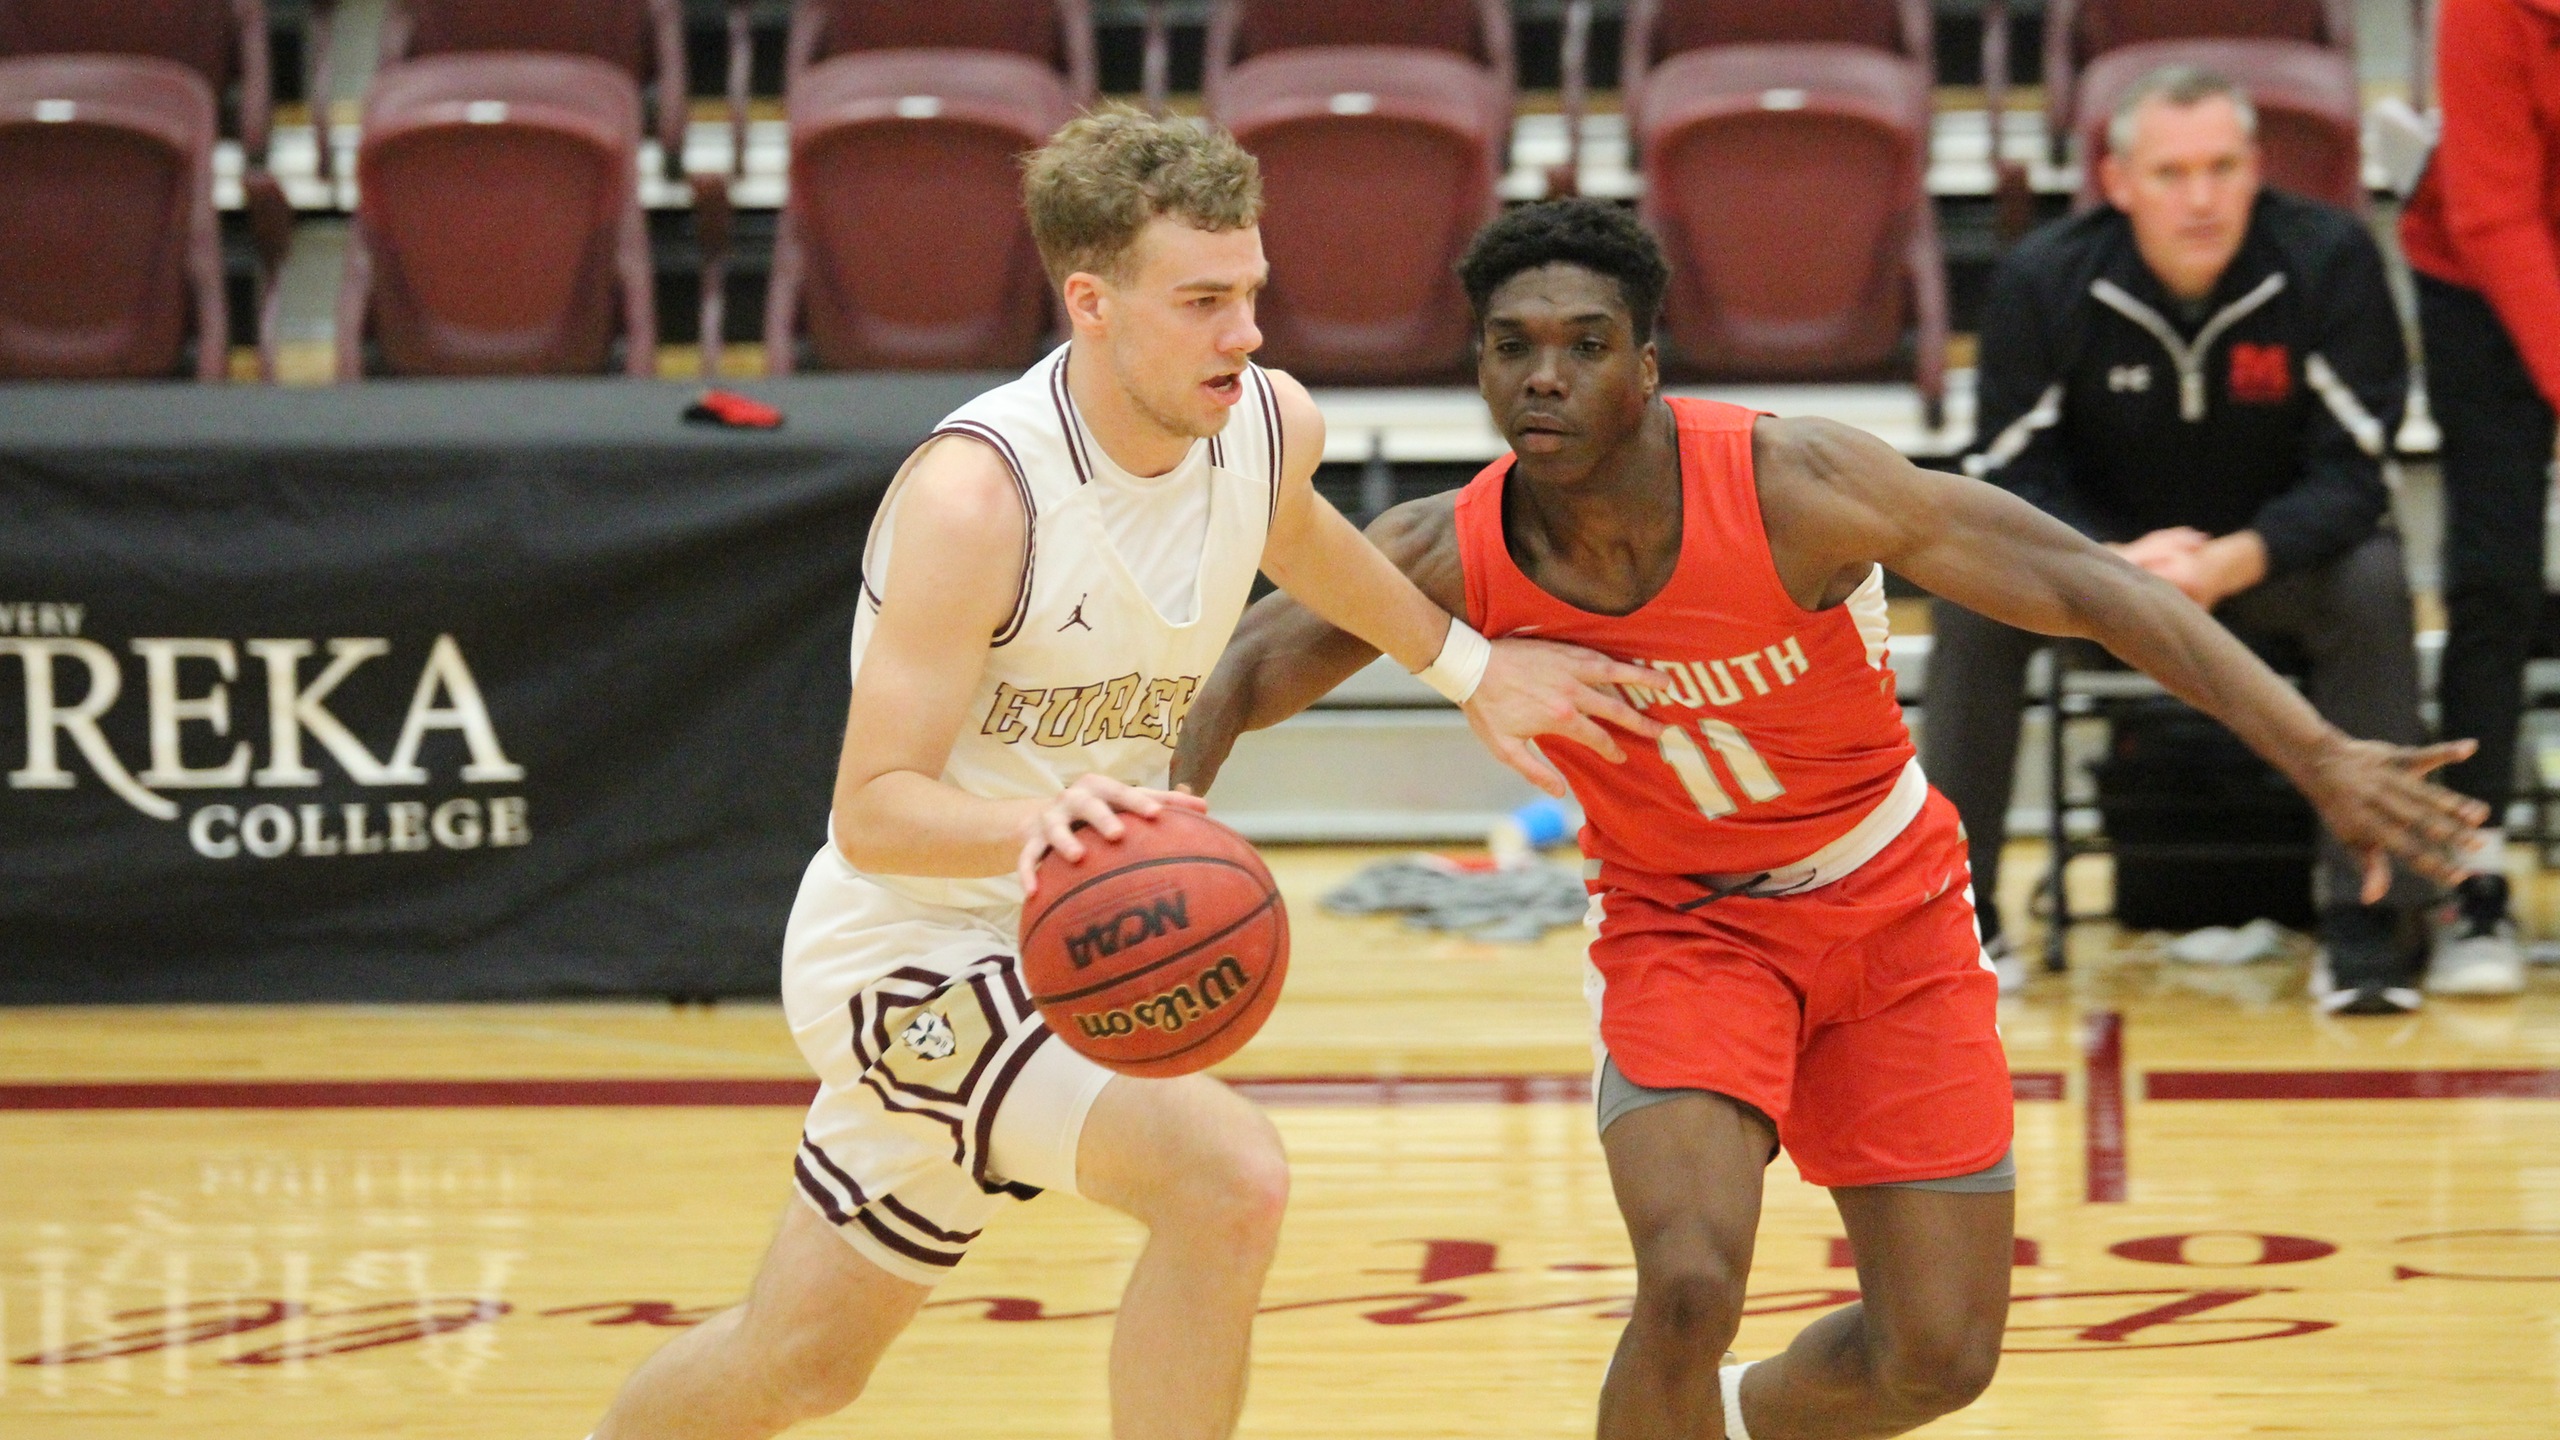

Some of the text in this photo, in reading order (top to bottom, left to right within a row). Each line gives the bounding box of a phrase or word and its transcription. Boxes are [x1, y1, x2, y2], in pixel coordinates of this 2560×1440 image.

[1657, 718, 1788, 822] 11
[188, 796, 532, 859] COLLEGE
[1063, 888, 1191, 971] NCAA
[1072, 953, 1251, 1040] Wilson
